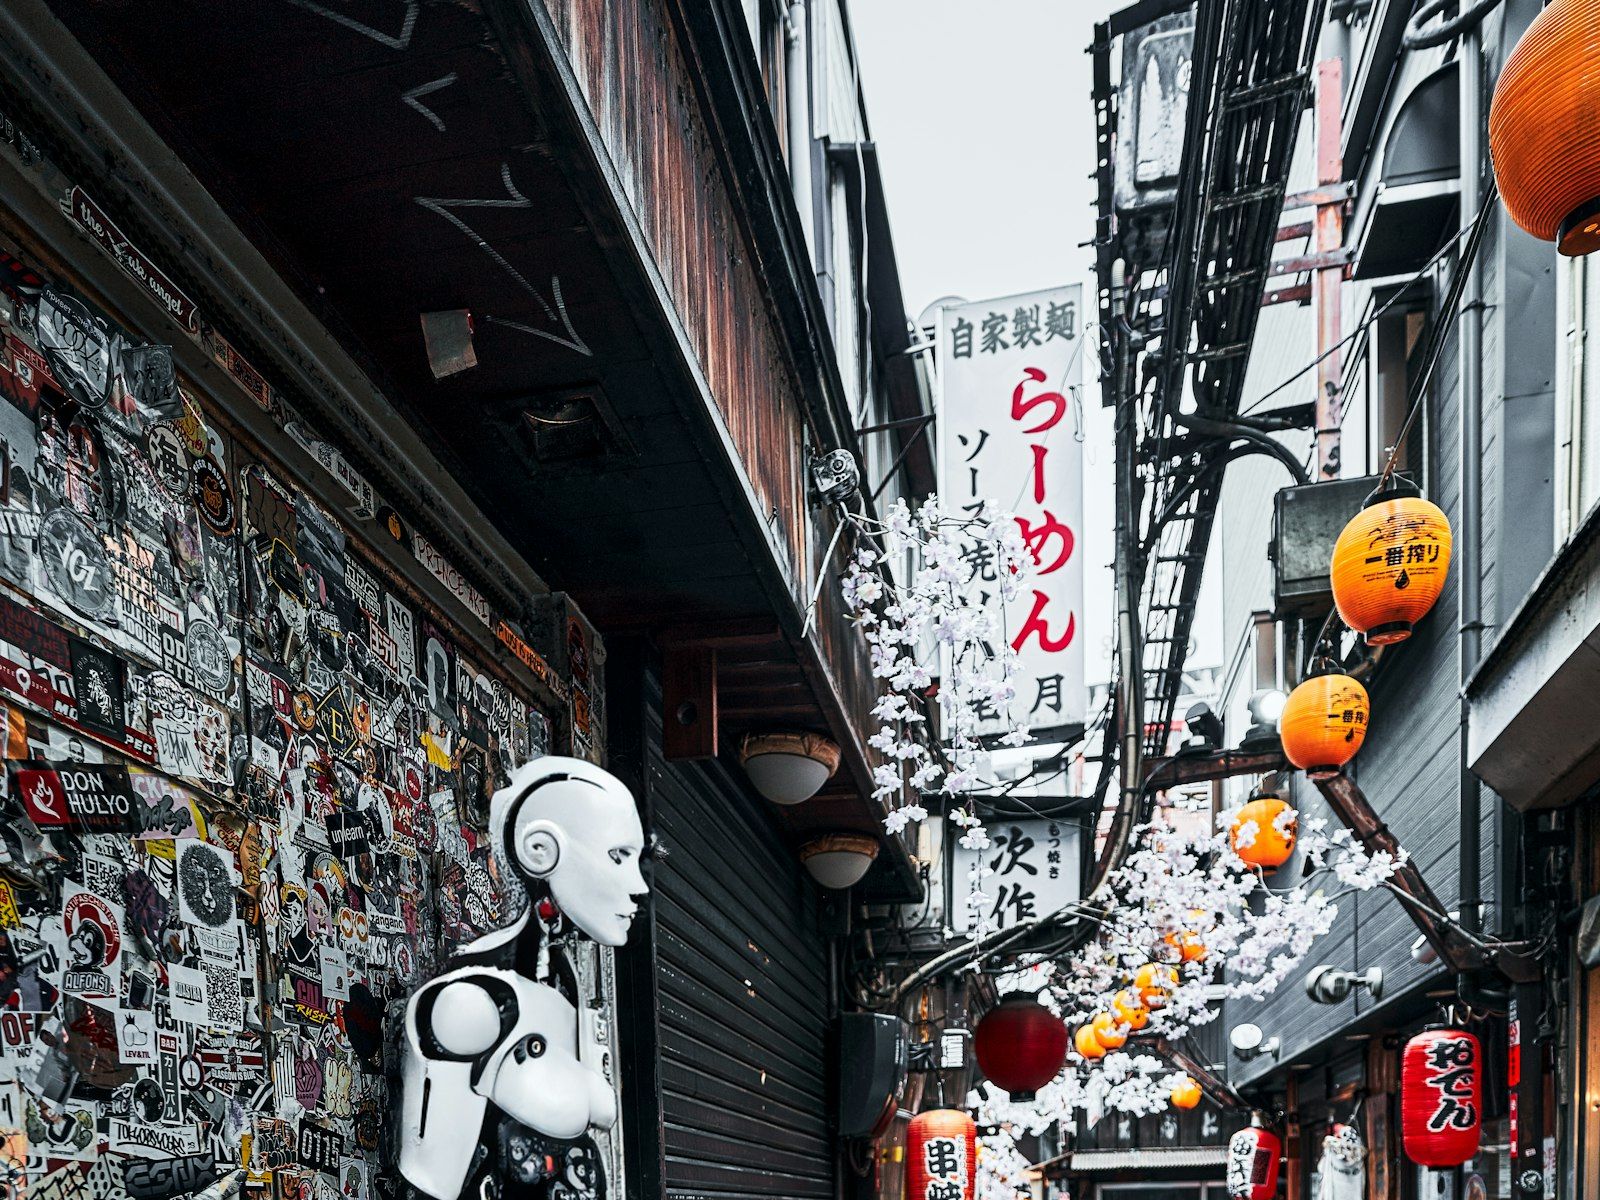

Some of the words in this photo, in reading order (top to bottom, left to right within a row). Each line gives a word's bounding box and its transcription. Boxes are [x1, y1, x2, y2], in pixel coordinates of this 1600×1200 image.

[951, 301, 1077, 360] 自家製麺
[1009, 366, 1076, 654] らーめん
[1365, 544, 1439, 567] 一番搾り
[60, 770, 105, 793] DON
[68, 793, 130, 815] HULYO
[295, 1003, 331, 1025] RUSH
[160, 1036, 177, 1051] BAR
[1426, 1039, 1477, 1132] おでん
